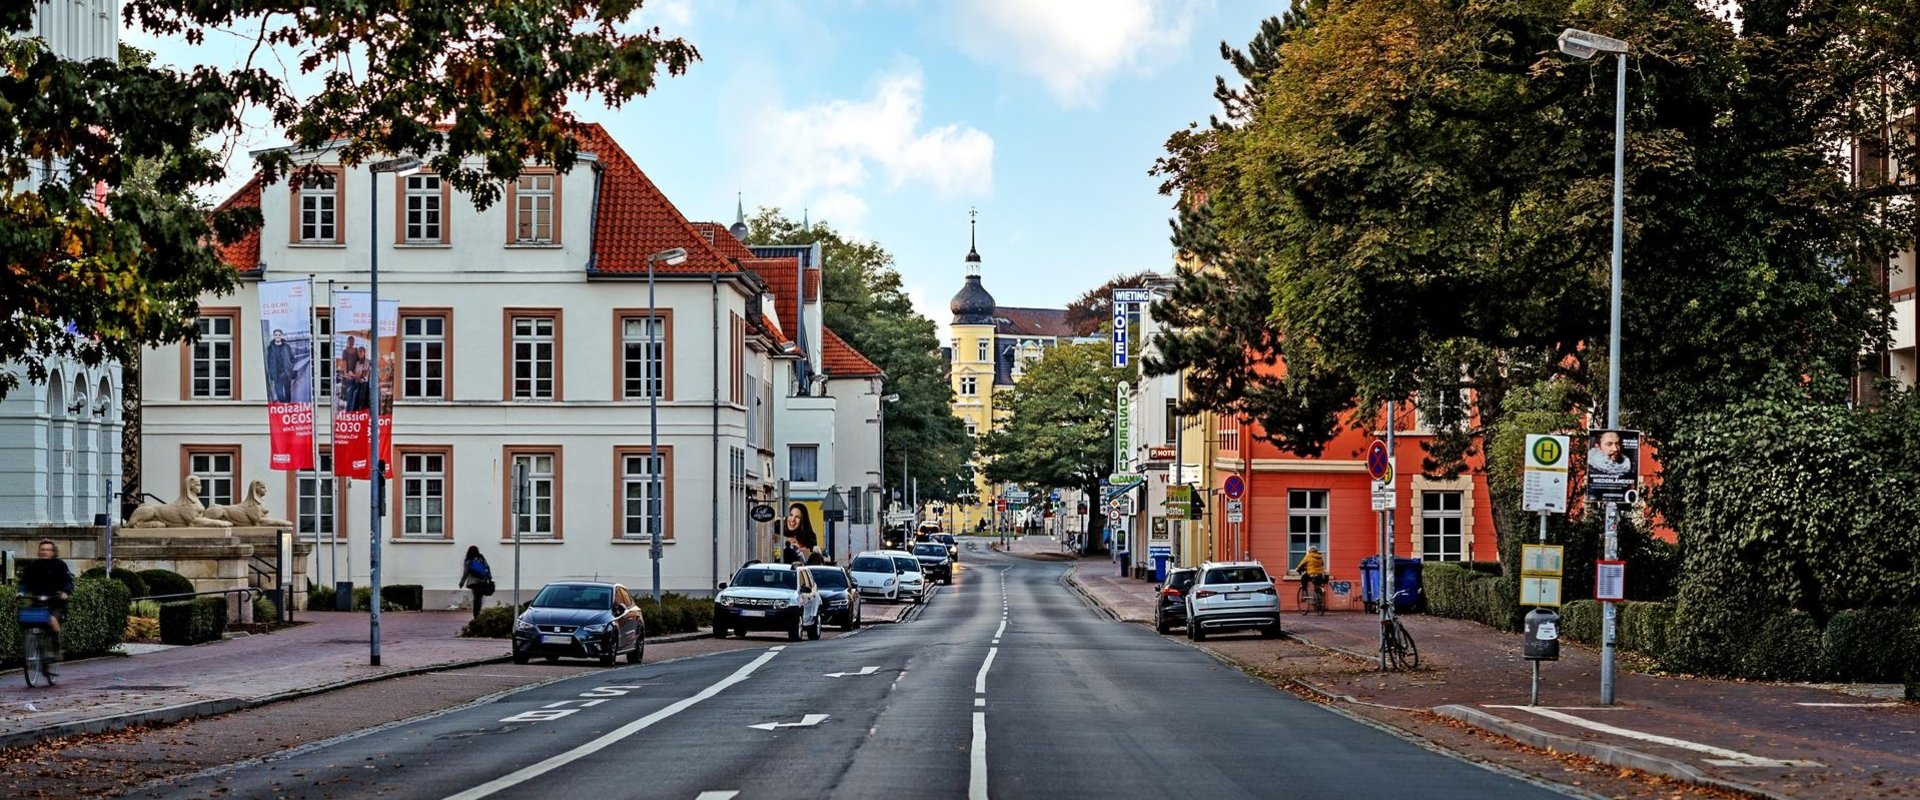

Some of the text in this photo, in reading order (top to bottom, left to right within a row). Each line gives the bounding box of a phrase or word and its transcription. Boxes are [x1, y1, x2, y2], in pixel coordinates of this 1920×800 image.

[1115, 291, 1149, 301] WIETING
[1114, 303, 1126, 367] HOTEL
[336, 422, 361, 433] 2030
[1119, 387, 1129, 471] VOSGERAU
[1541, 443, 1554, 459] H
